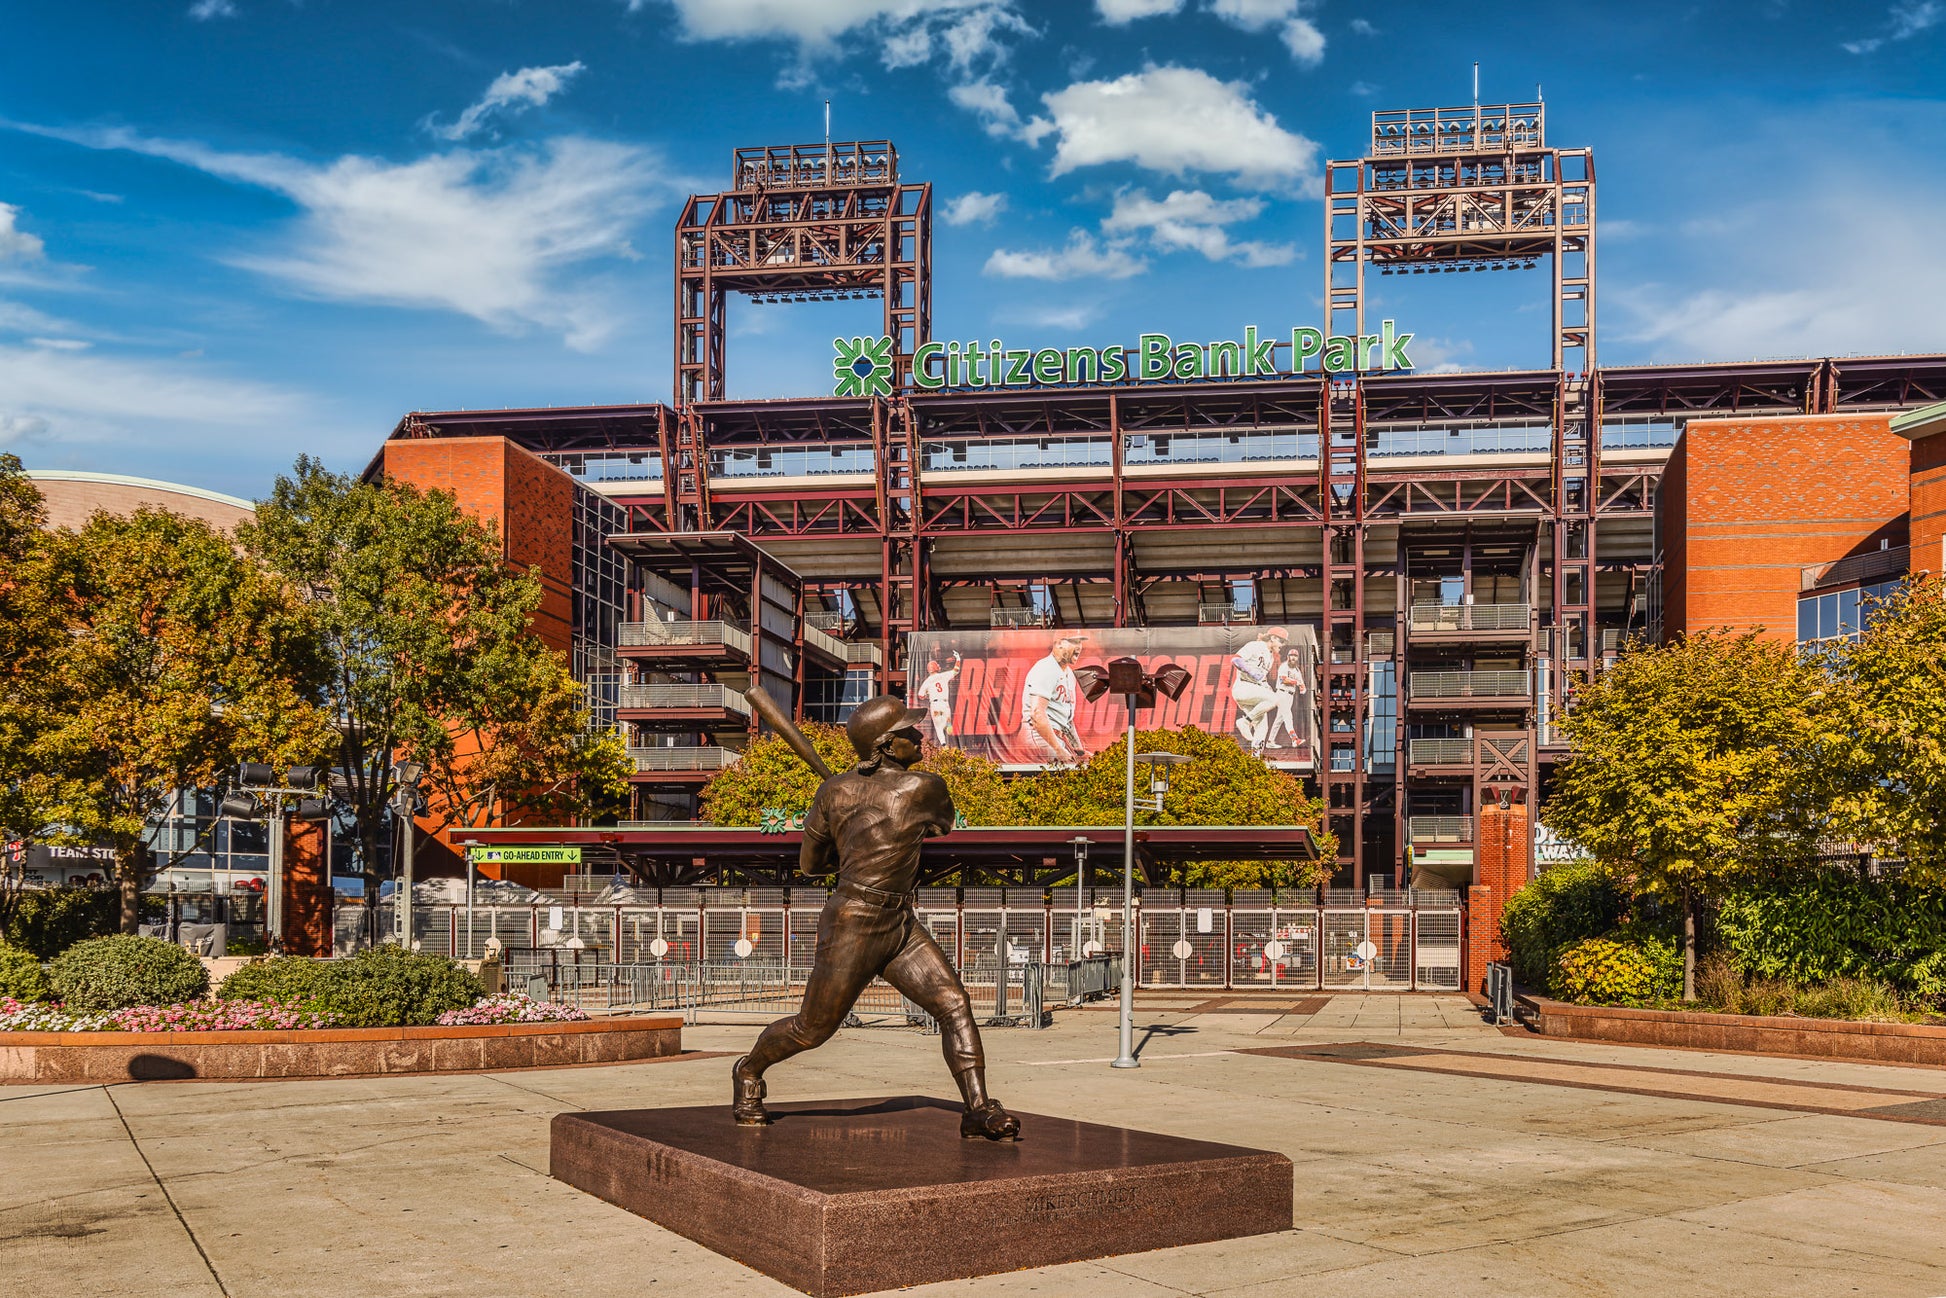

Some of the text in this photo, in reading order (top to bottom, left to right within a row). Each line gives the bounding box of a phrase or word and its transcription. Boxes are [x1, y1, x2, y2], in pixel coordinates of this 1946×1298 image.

[912, 319, 1416, 388] Citizens Bank Park
[935, 682, 943, 693] 3
[951, 657, 1027, 735] RED
[48, 846, 116, 860] TEAM STO
[503, 851, 565, 860] GO-AHEAD ENTRY
